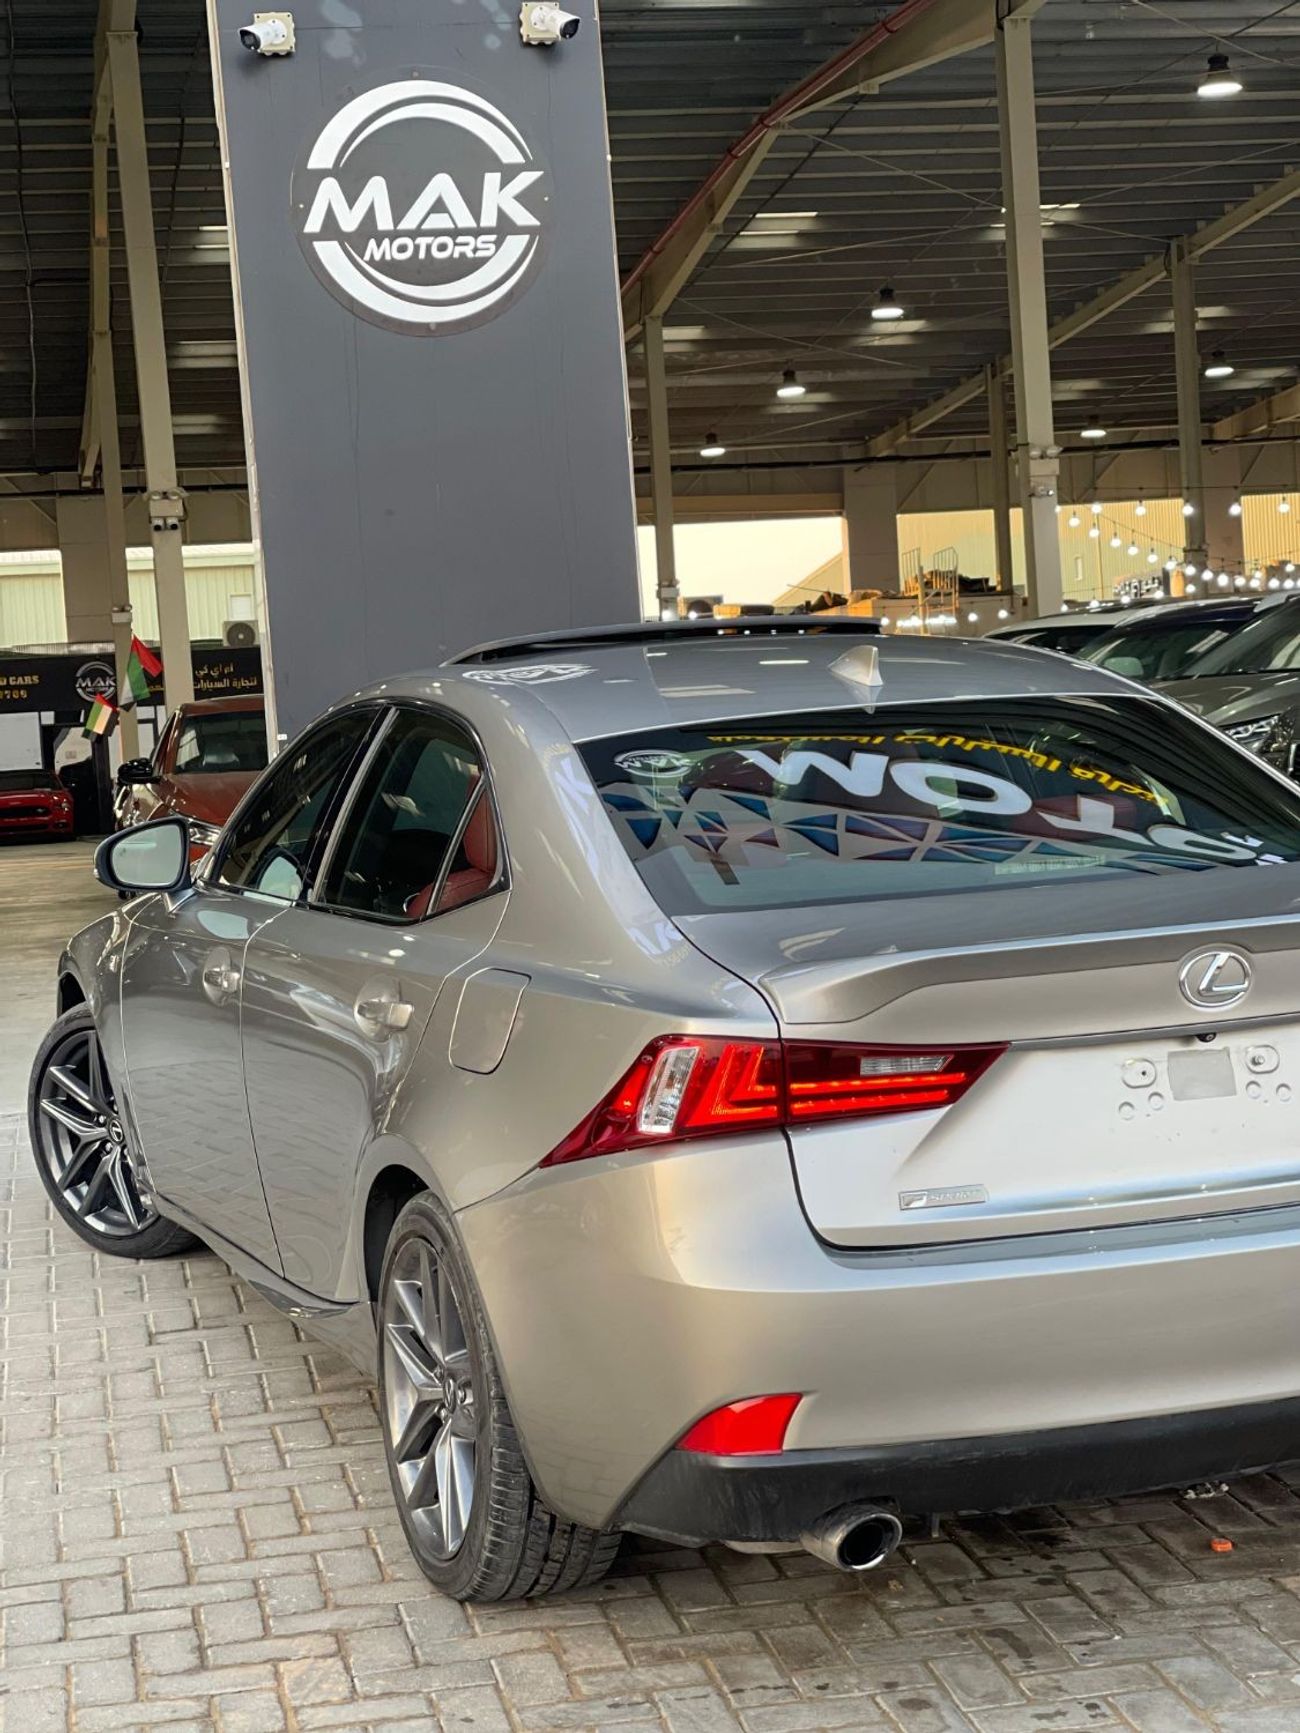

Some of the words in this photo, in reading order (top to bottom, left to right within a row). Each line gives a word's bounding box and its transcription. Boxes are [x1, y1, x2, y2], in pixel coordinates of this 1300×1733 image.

[303, 171, 544, 233] MAK
[363, 234, 498, 261] MOTORS
[9, 674, 40, 685] CARS
[75, 676, 116, 687] MAK
